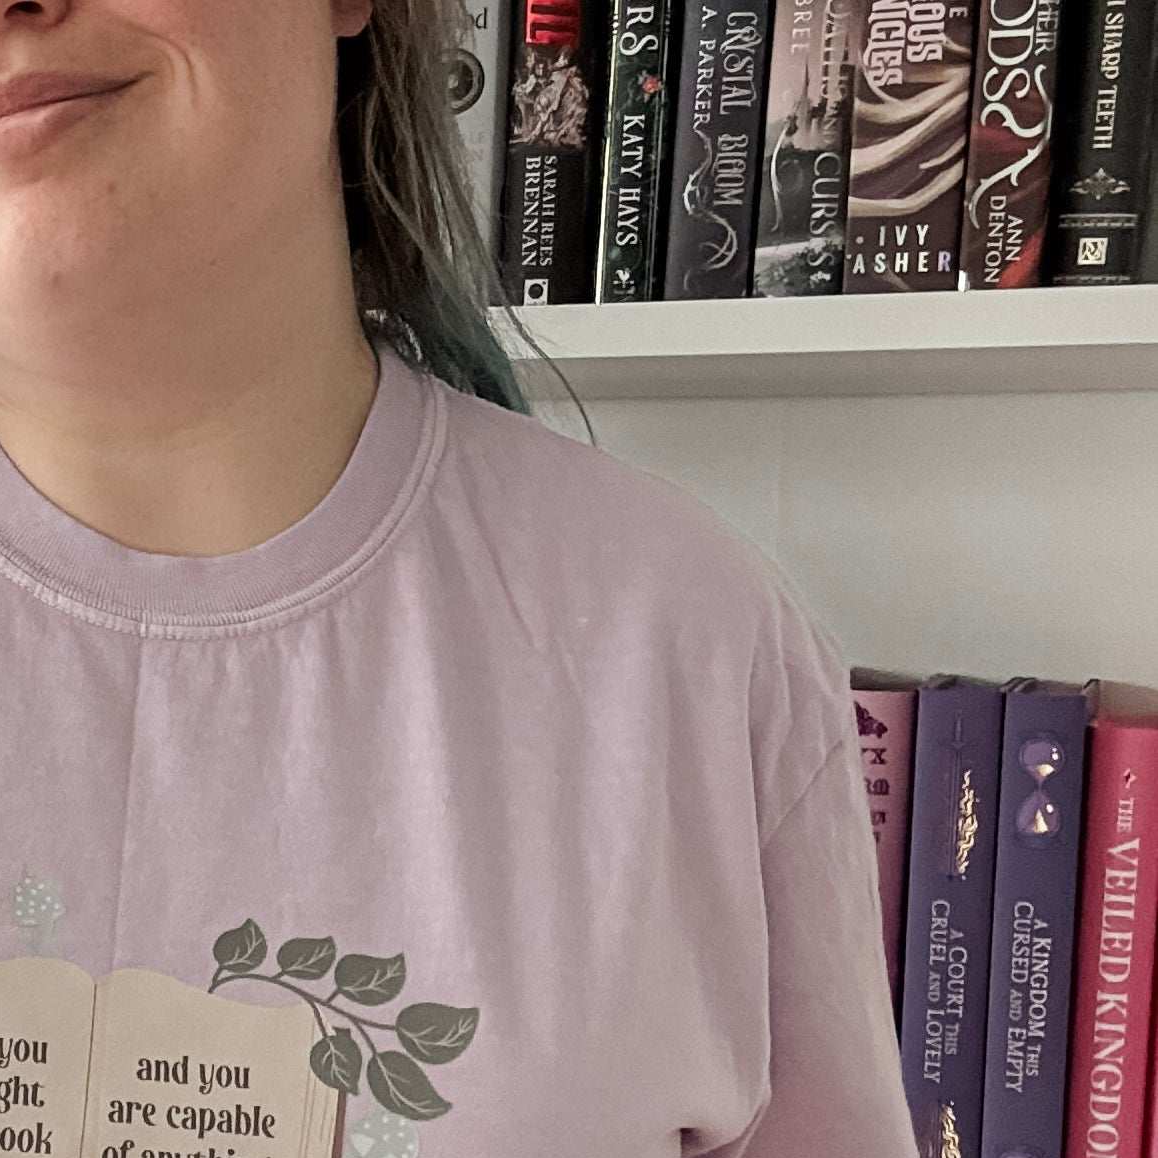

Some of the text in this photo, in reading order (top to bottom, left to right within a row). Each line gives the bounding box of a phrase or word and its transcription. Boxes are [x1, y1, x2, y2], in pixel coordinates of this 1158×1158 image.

[693, 38, 717, 129] PARKER
[720, 11, 762, 116] CRYSTAL
[1100, 12, 1125, 80] SHARP
[1092, 85, 1119, 149] TEETH
[521, 156, 542, 267] BRENNAN
[539, 155, 558, 267] SARAH REES
[615, 113, 646, 247] KATY HAYS
[852, 250, 952, 275] ASHER
[878, 224, 930, 248] IVY
[983, 195, 1007, 283] DENTON
[1006, 214, 1024, 262] ANN
[1117, 798, 1134, 833] THE
[1098, 837, 1140, 983] VEILED
[923, 900, 951, 1084] CRUEL AND LOVELY
[945, 928, 968, 1055] A COURT THIS
[1005, 901, 1034, 1093] CURSED AND EMPTY
[1025, 918, 1052, 1077] A KINGDOM THIS
[108, 1099, 276, 1139] are capable
[137, 1055, 250, 1094] and you
